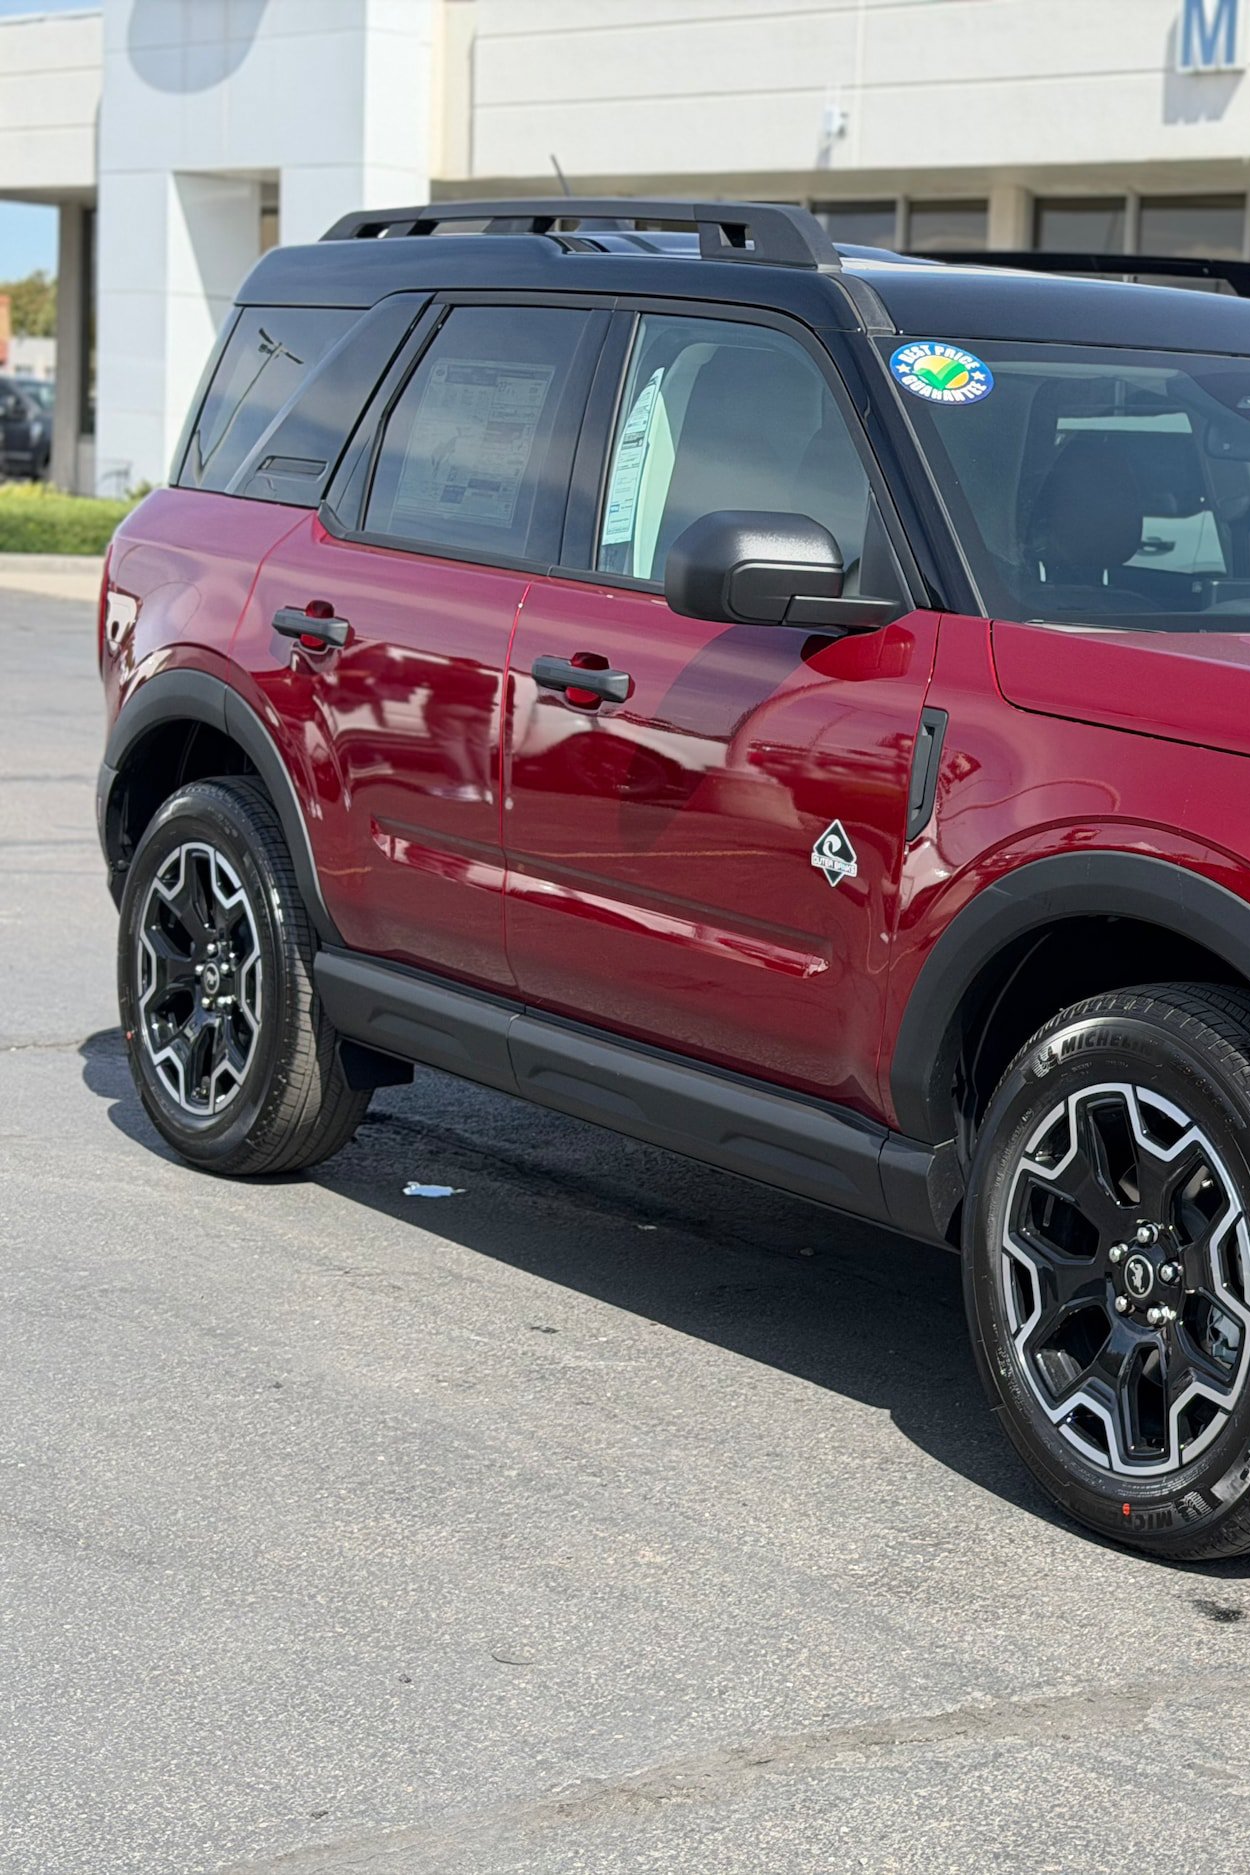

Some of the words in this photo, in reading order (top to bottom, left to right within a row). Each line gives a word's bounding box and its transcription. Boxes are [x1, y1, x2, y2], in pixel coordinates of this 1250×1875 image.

[898, 344, 932, 364] BEST
[934, 345, 980, 370] PRICE
[901, 374, 988, 402] GUARANTEE
